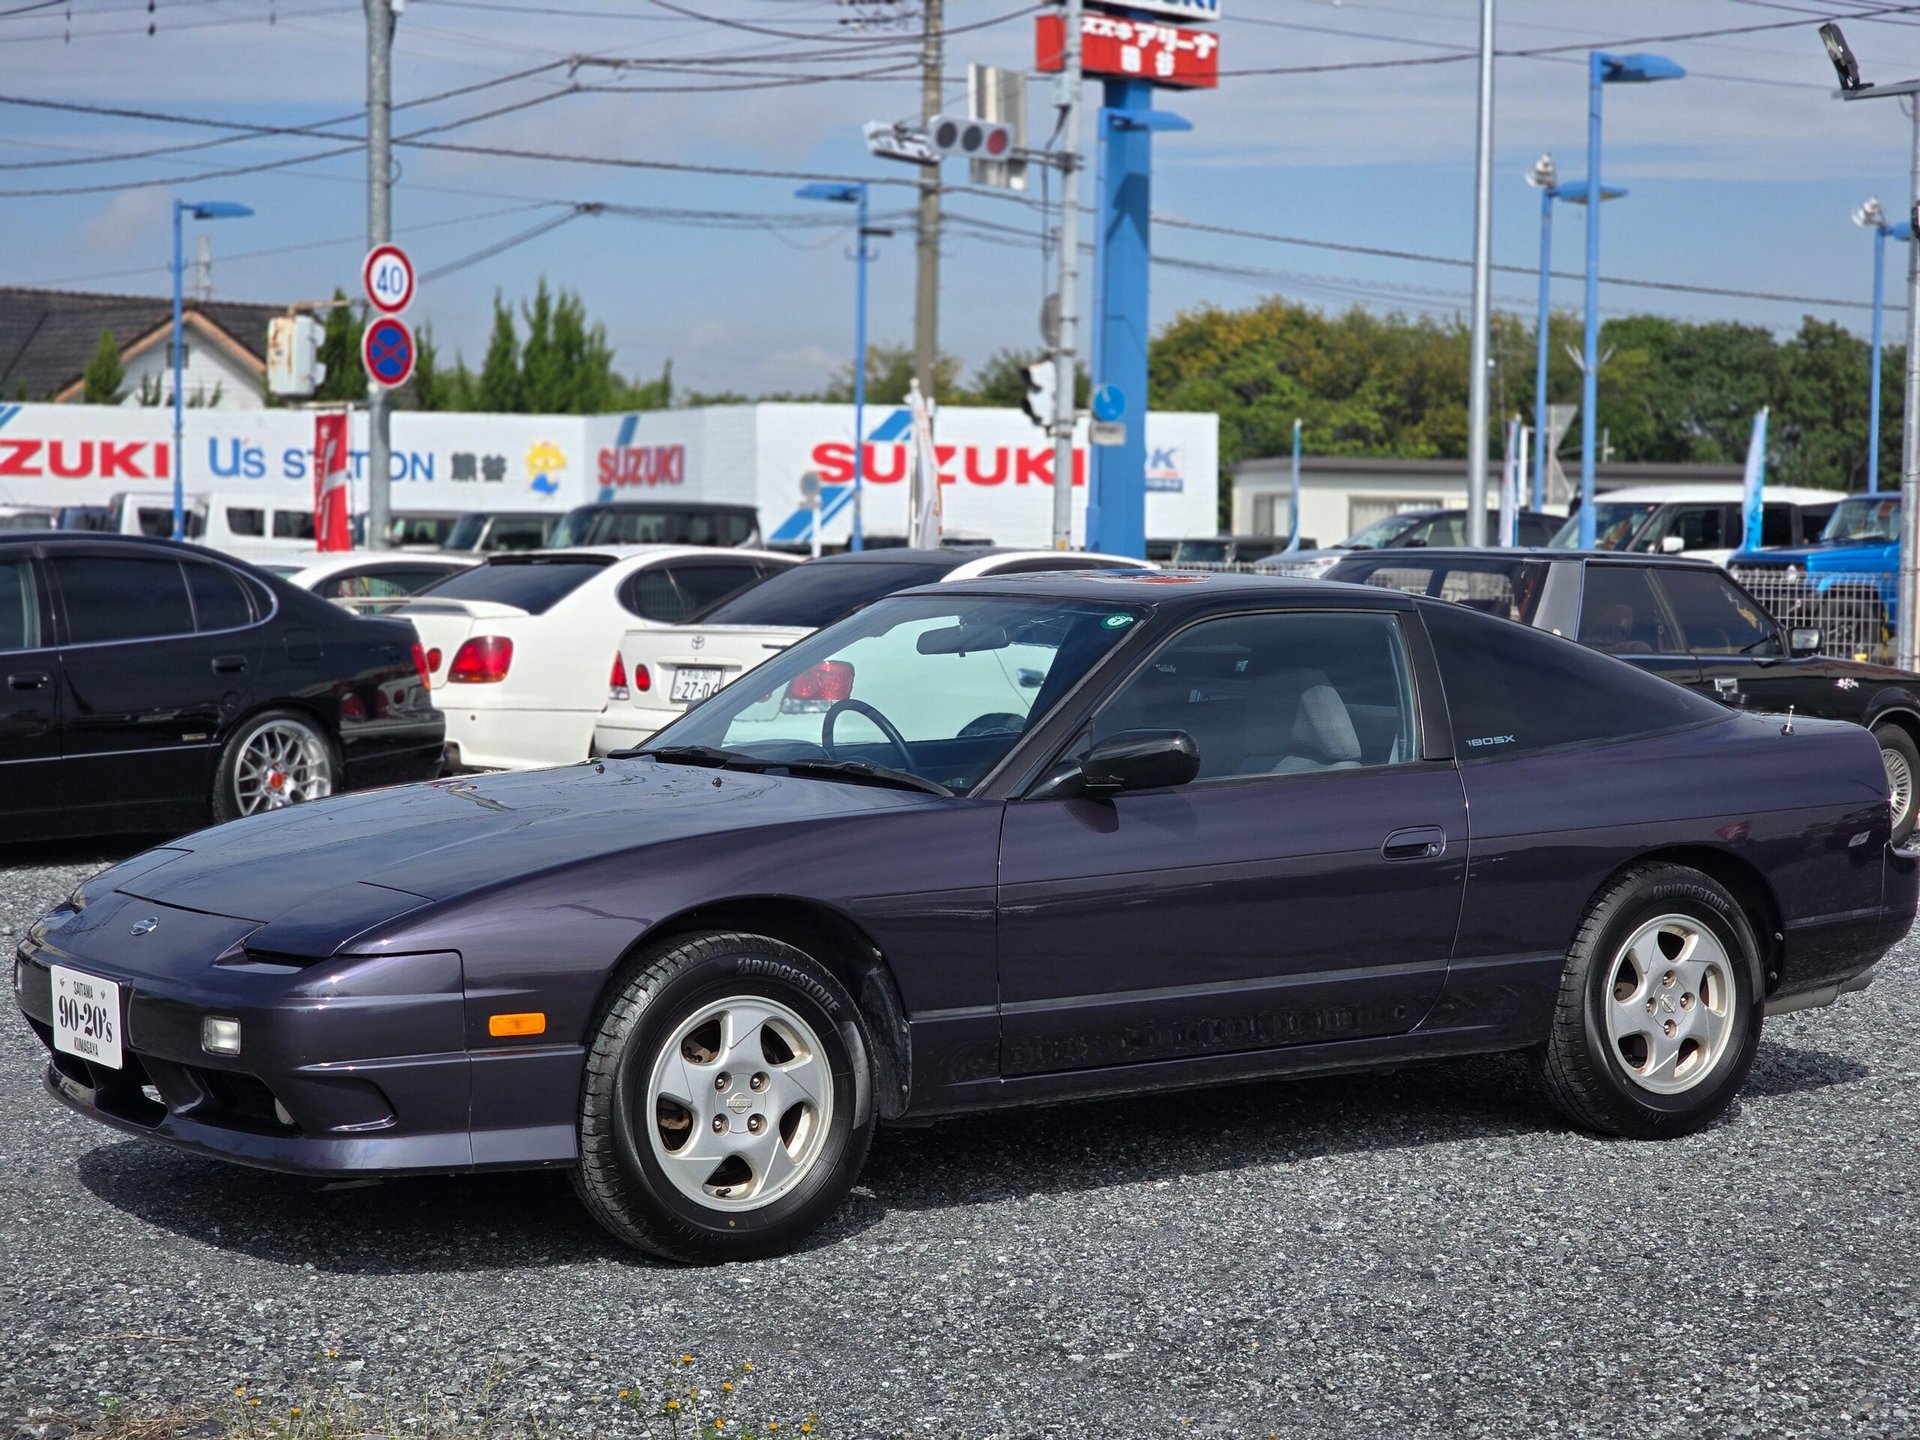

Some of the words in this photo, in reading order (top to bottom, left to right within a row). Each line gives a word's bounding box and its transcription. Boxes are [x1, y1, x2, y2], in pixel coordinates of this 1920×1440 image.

[377, 265, 404, 295] 40
[0, 438, 169, 479] ZUKI
[282, 447, 435, 482] STON
[597, 443, 685, 488] SUZUKI
[1465, 734, 1516, 748] 180SX
[73, 980, 94, 1001] SAITAMA
[736, 957, 842, 1015] BRIDGESTONE
[58, 994, 114, 1044] 90-20's
[73, 1036, 100, 1058] KUMAGAYA
